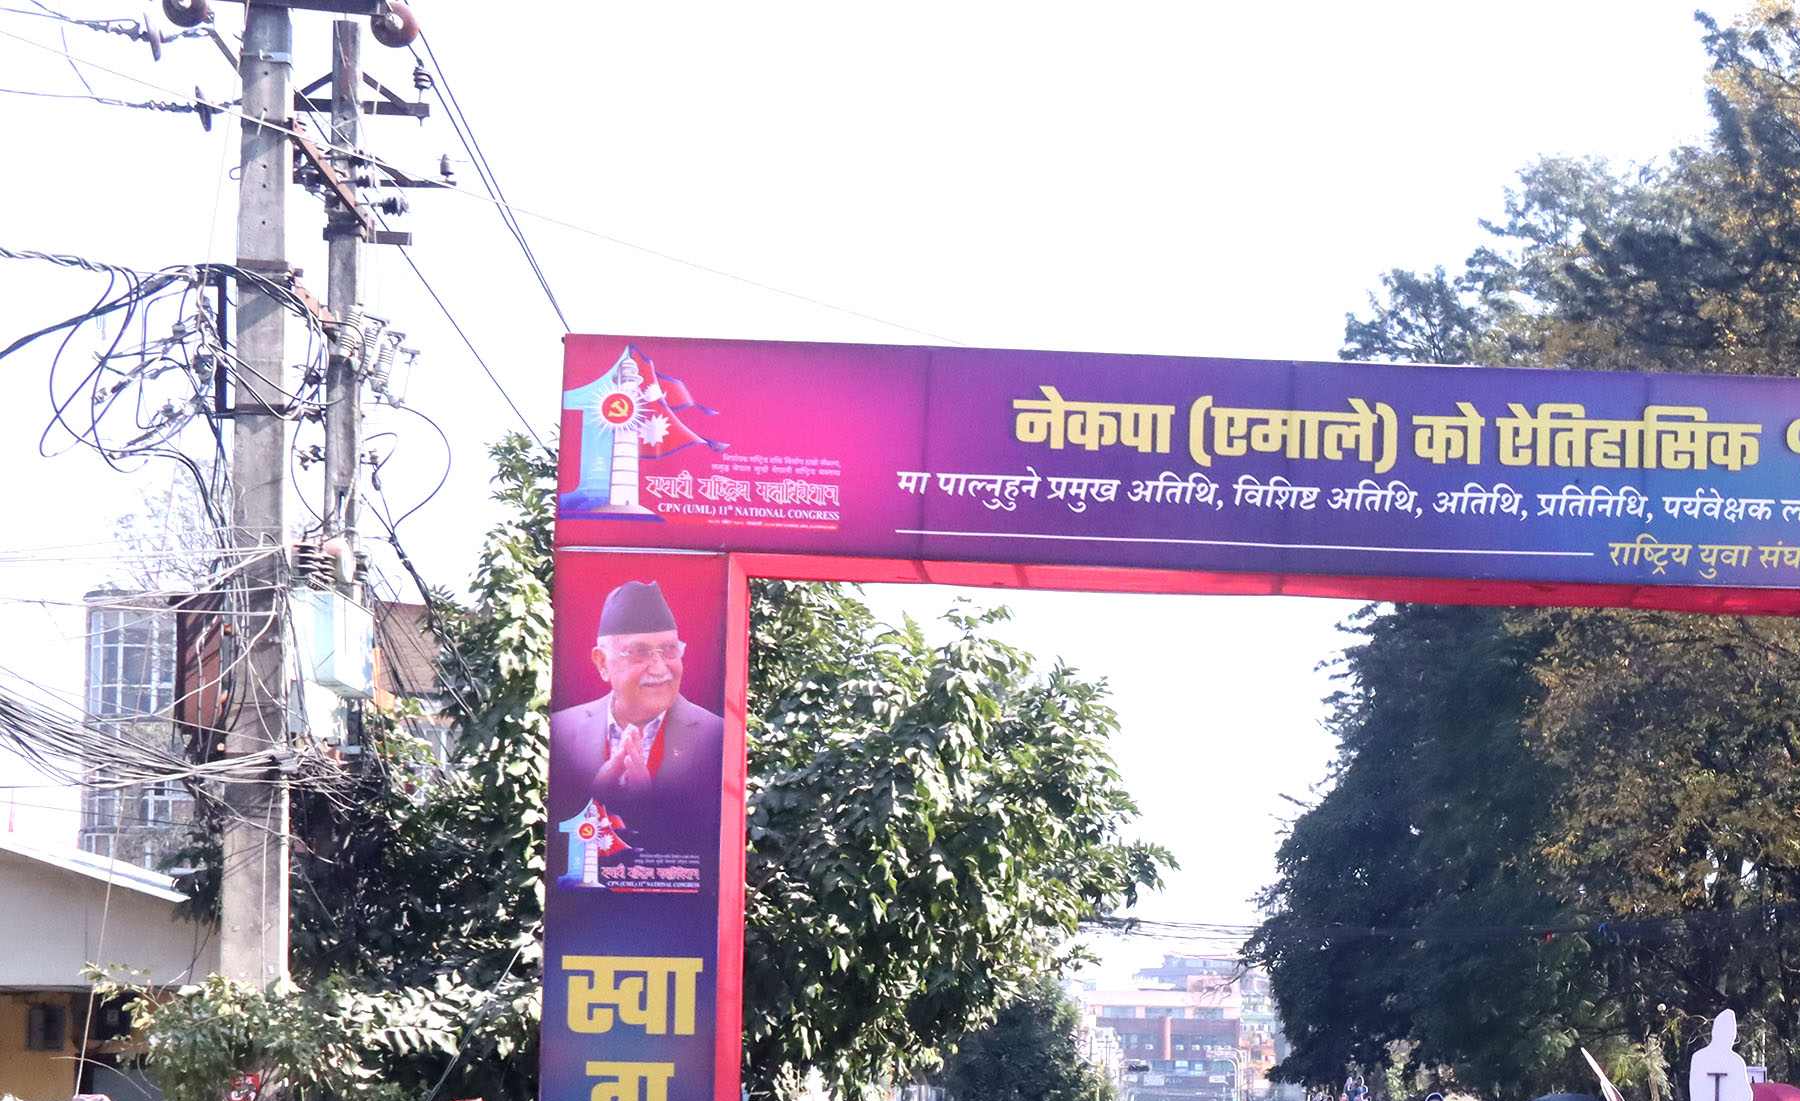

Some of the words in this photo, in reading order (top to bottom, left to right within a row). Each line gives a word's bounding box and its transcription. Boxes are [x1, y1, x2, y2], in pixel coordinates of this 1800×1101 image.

[1014, 385, 1174, 453] नेकपा
[1190, 395, 1397, 473] (एमाले)
[1413, 401, 1483, 464] को
[1497, 402, 1762, 470] ऐतिहासिक
[657, 503, 681, 513] CPN
[683, 504, 716, 516] (UML)
[735, 507, 786, 519] NATIONAL
[787, 508, 840, 521] CONGRESS
[897, 472, 931, 494] मा
[936, 466, 1041, 511] पाल्नुहुने
[1047, 477, 1121, 512] प्रमुख
[1128, 474, 1223, 510] अतिथि,
[1233, 476, 1320, 509] विशिष्ट
[1327, 480, 1422, 518] अतिथि,
[1433, 483, 1527, 521] अतिथि,
[1537, 486, 1653, 523] प्रतिनिधि,
[1663, 490, 1773, 523] पर्यवेक्षक
[1610, 532, 1691, 576] राष्ट्रिय
[1699, 543, 1753, 579] युवा
